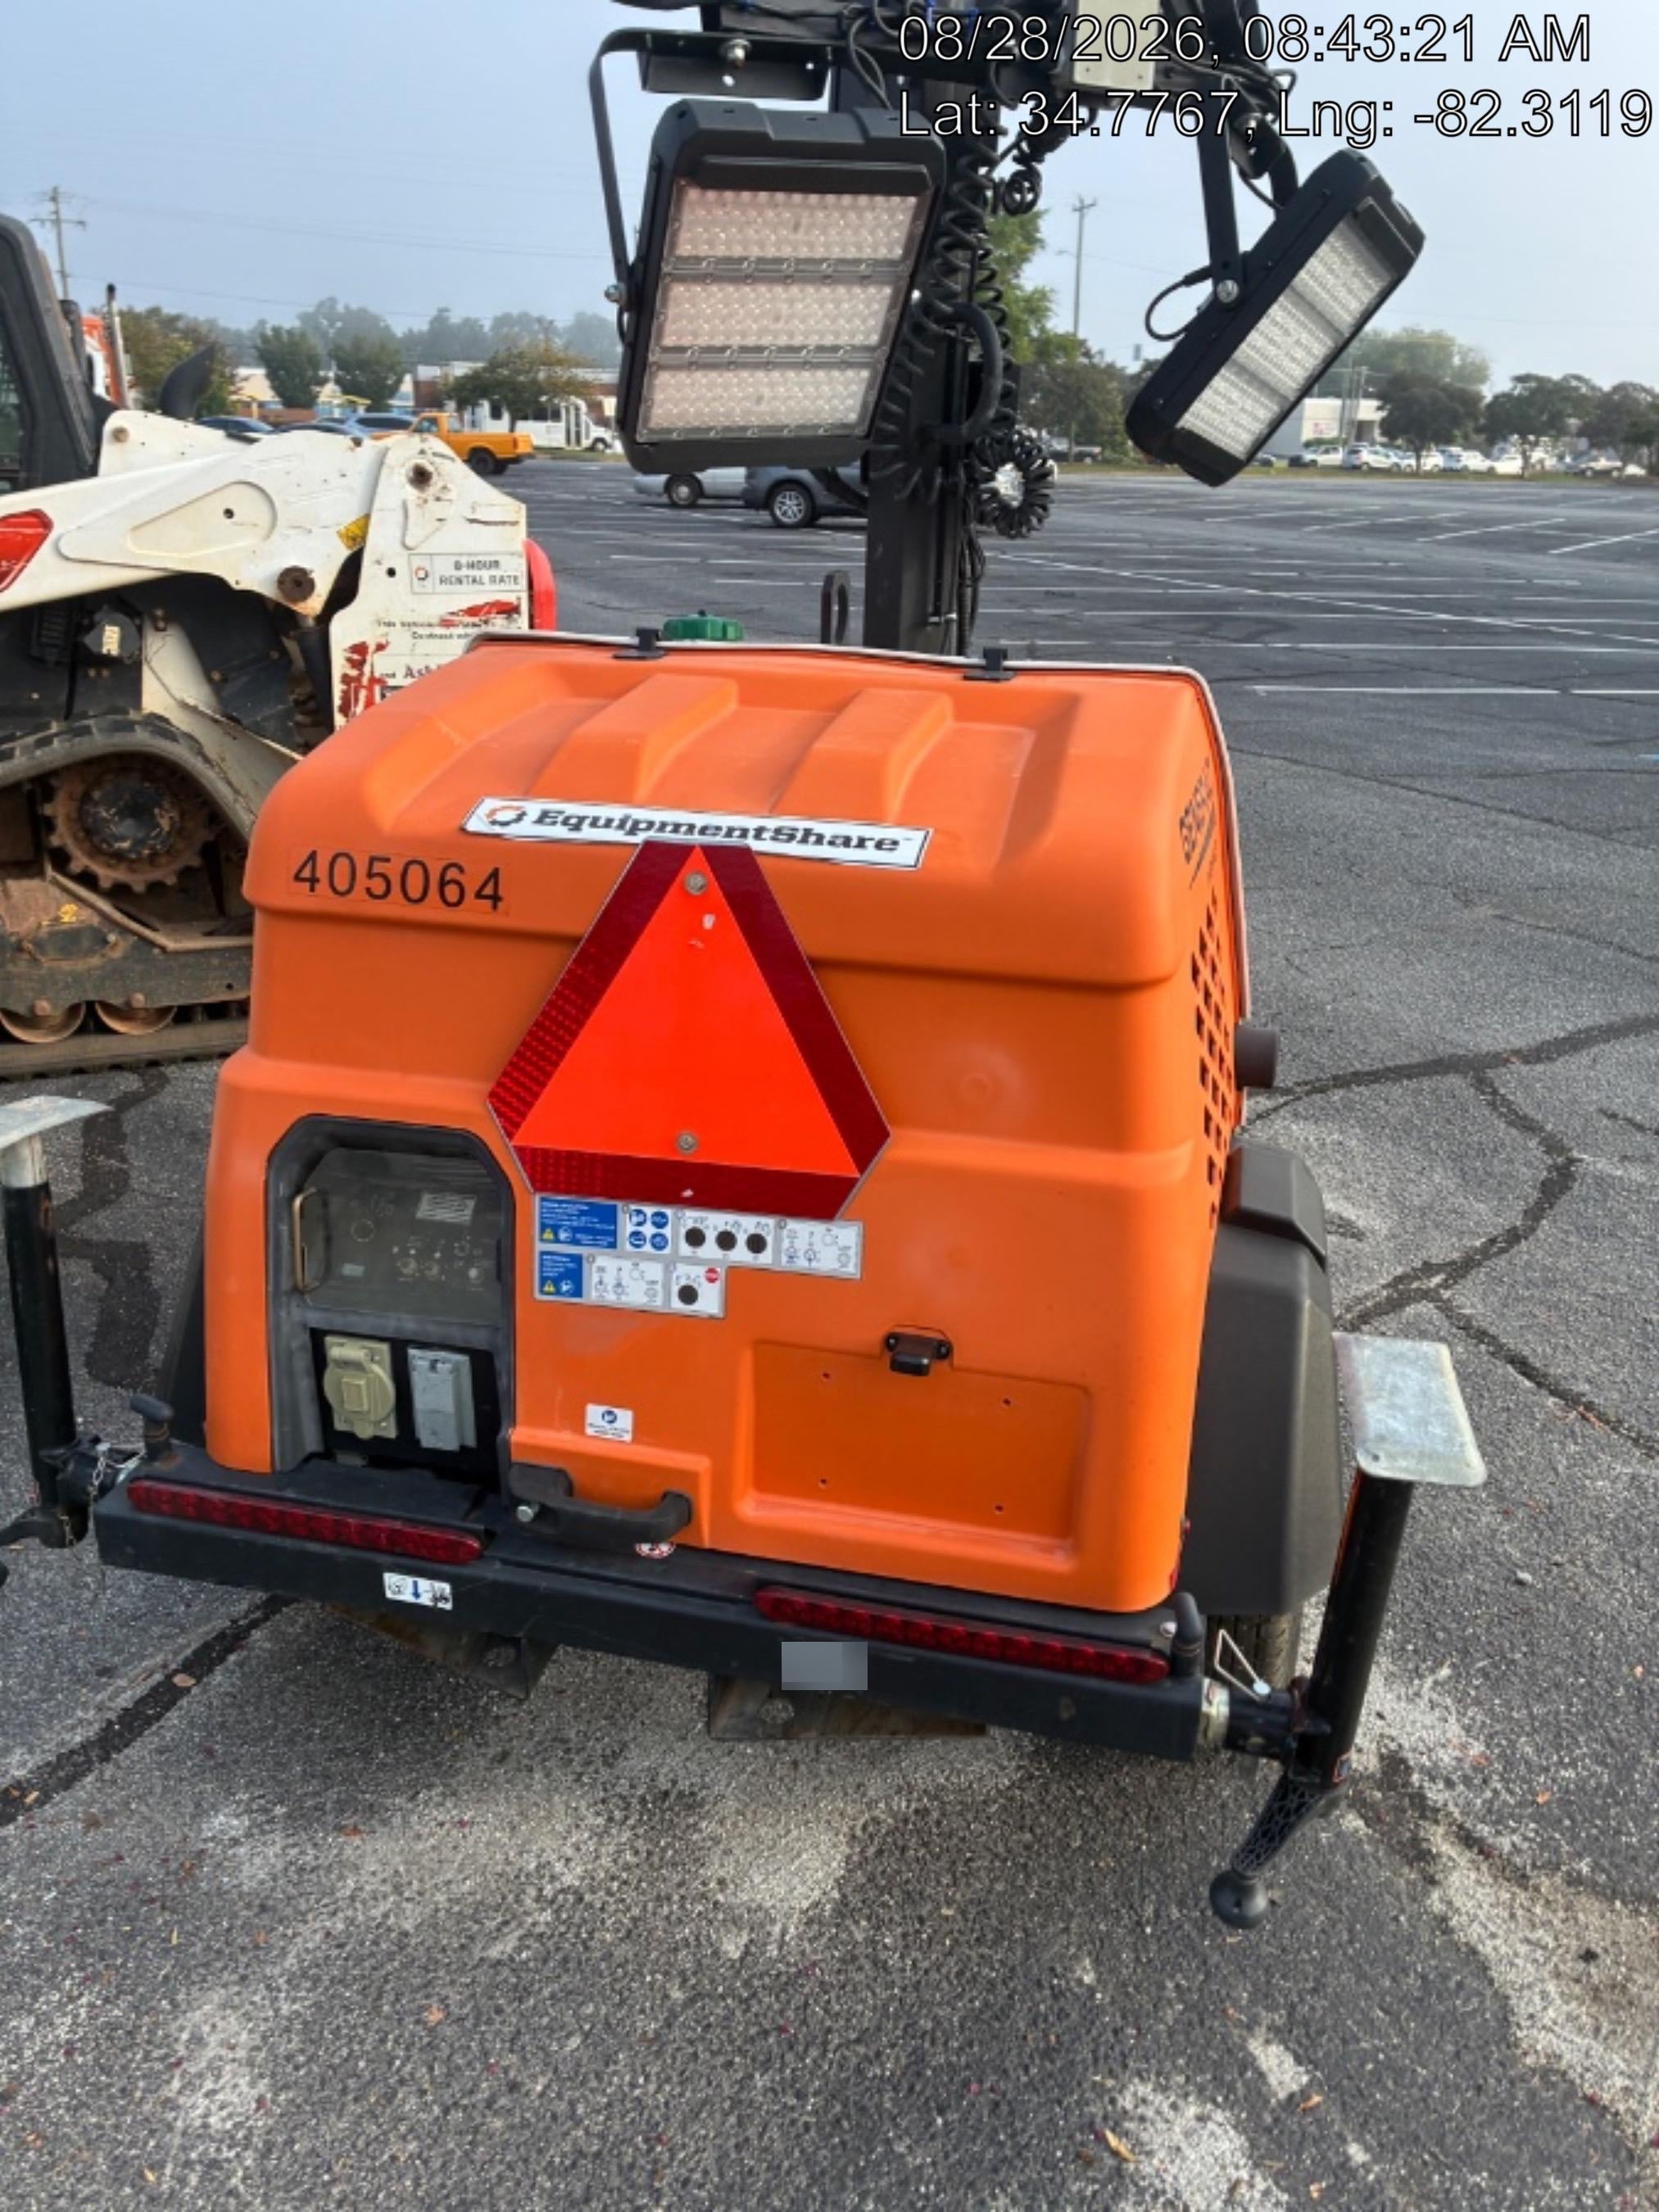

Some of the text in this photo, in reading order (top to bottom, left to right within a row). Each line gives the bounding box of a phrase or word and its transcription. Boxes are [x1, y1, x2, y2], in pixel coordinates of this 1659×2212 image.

[438, 574, 520, 586] RENTAL RATE
[534, 807, 901, 854] EquipmentShare
[292, 849, 505, 912] 405064
